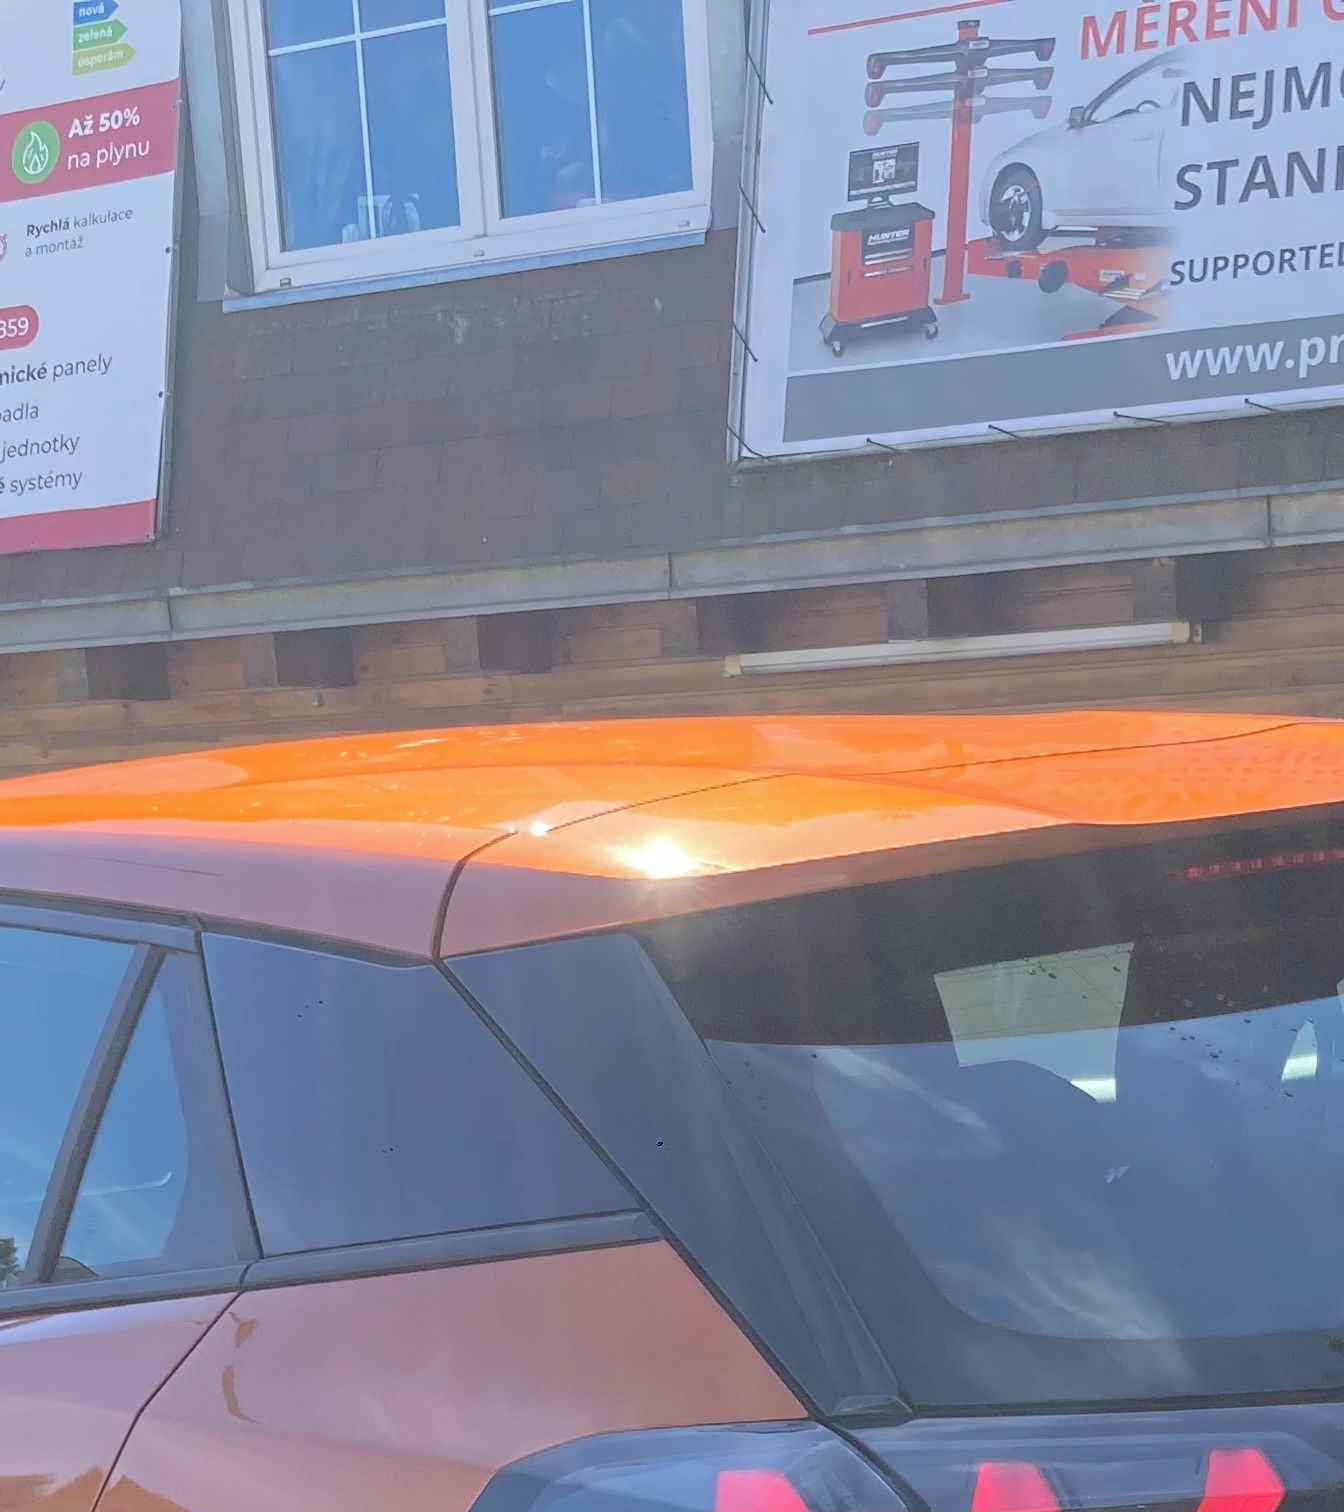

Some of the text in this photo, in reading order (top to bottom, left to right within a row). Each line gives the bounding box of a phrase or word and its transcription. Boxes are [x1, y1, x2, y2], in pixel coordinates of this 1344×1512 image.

[79, 2, 104, 17] nová
[78, 26, 112, 43] zelená
[78, 50, 123, 68] úsporám
[68, 107, 140, 138] Až 50%
[67, 139, 150, 170] na plynu
[26, 207, 133, 239] Rychlá kalkulace
[868, 229, 910, 243] HUNTER
[25, 237, 83, 257] a montáž
[52, 353, 113, 382] panely
[0, 433, 80, 463] jednotky
[9, 470, 83, 496] systémy
